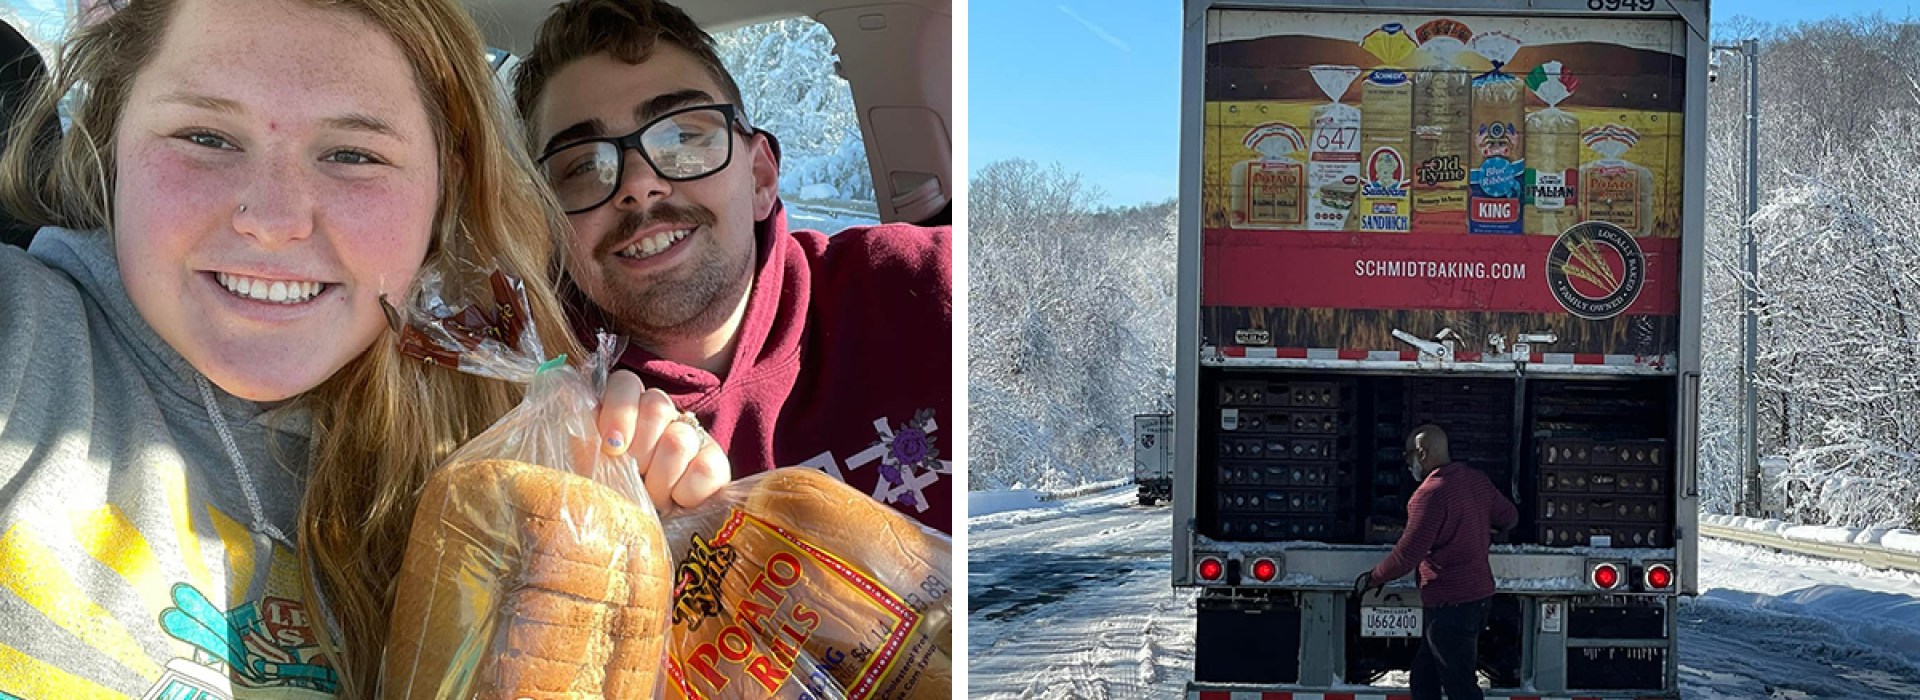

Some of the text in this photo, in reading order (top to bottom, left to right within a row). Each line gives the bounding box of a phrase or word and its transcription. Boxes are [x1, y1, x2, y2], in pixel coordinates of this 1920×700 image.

[1317, 126, 1357, 149] 647
[1429, 155, 1460, 172] Old
[1418, 168, 1465, 187] Tyme
[1525, 186, 1574, 198] ITALIAN
[1480, 203, 1512, 218] KING
[1361, 215, 1407, 230] SANDWICH
[1598, 230, 1632, 257] LOCALLY
[1355, 259, 1526, 279] SCHMIDTBAKING.COM
[1559, 285, 1624, 312] FAMILY OWNED
[1367, 615, 1417, 629] U662400
